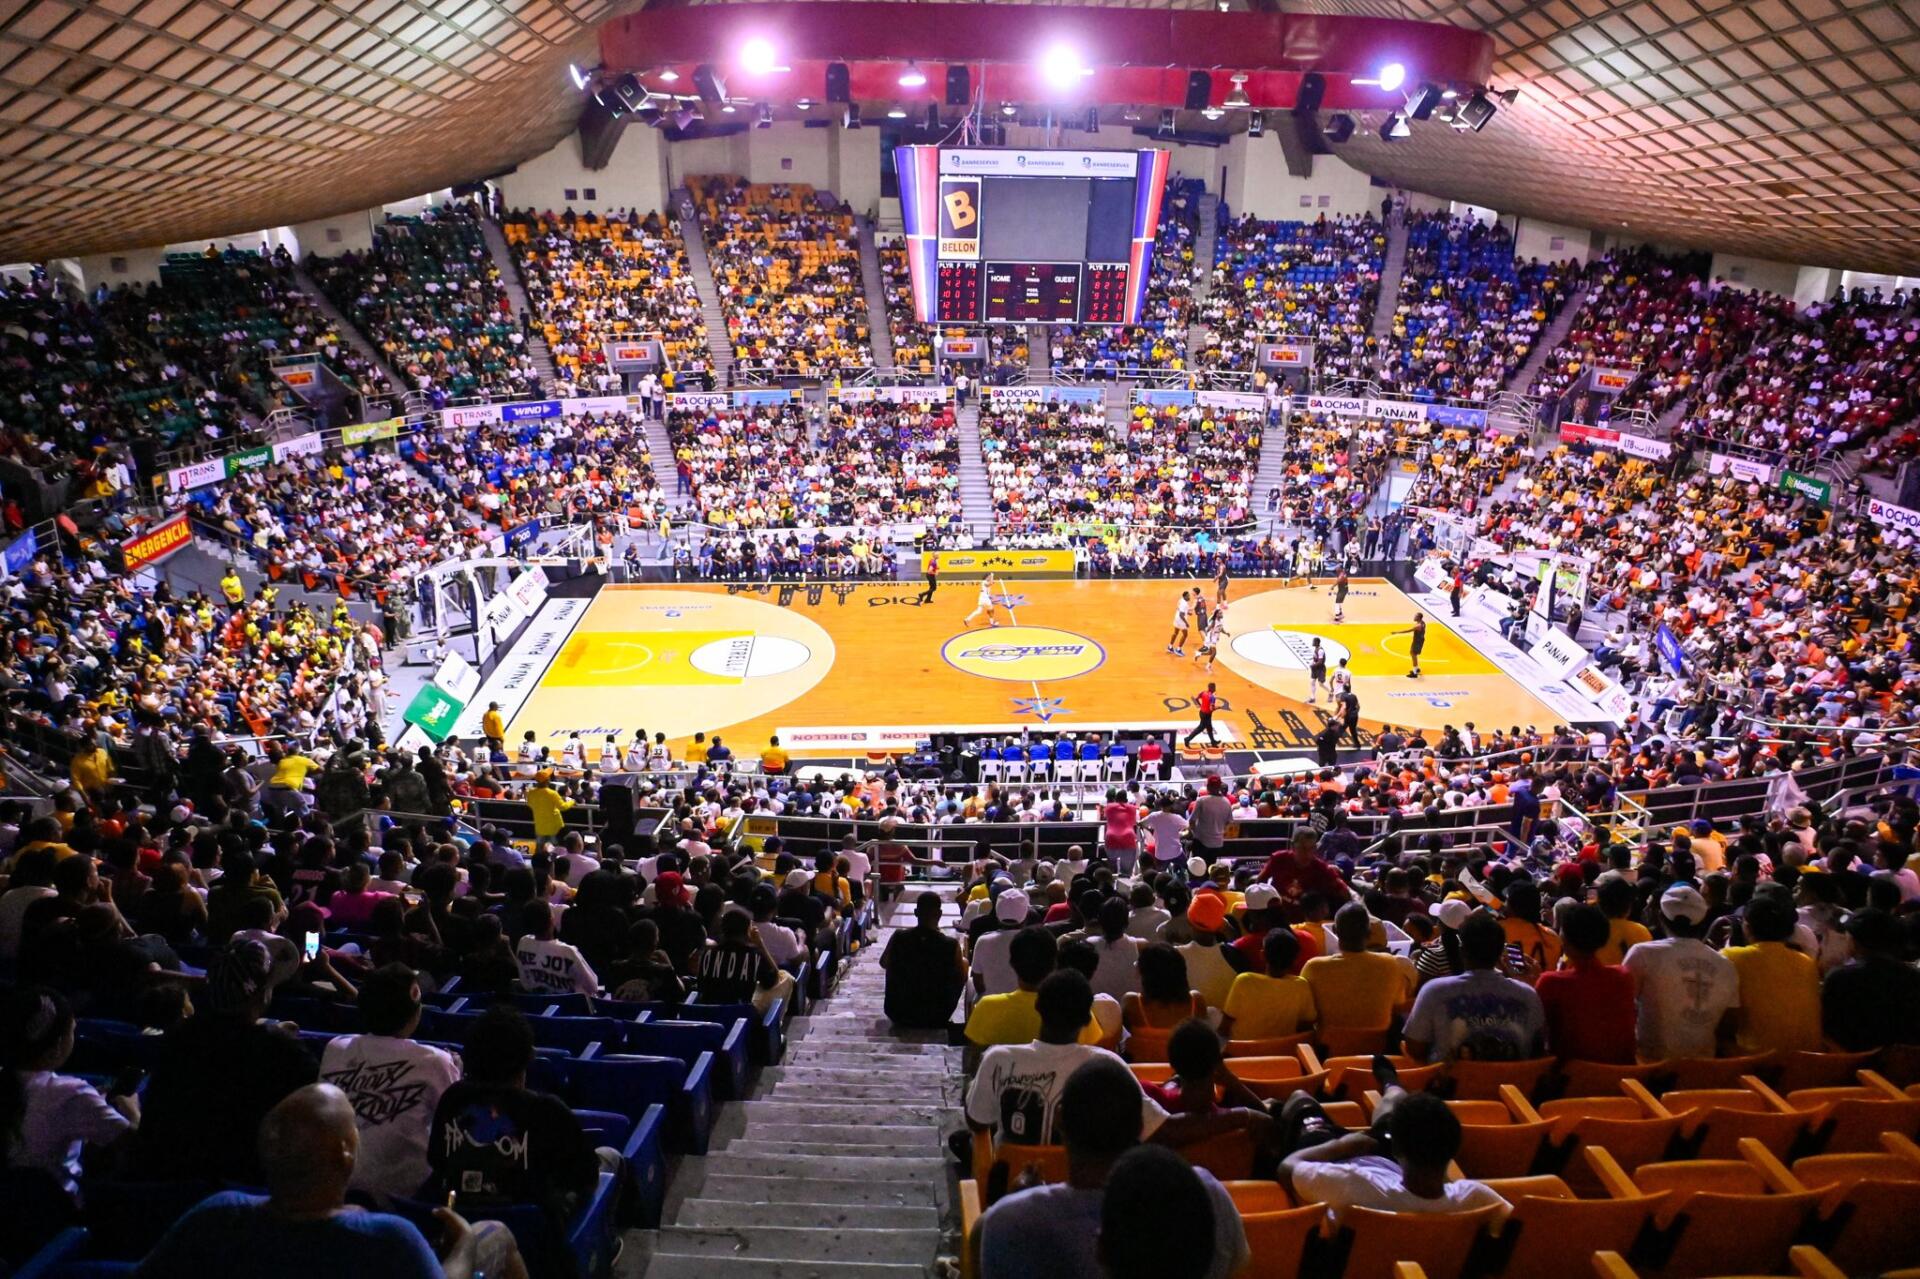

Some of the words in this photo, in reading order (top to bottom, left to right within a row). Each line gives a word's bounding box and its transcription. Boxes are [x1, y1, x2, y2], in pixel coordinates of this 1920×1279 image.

[942, 242, 976, 253] BELLON
[991, 275, 1011, 283] HOME
[1054, 276, 1076, 284] GUEST
[1006, 389, 1040, 397] OCHOA
[689, 396, 725, 405] OCHOA
[1324, 400, 1361, 410] OCHOA
[463, 410, 493, 421] TRANS
[512, 406, 542, 416] WIND
[1375, 406, 1419, 419] PANAM
[239, 451, 268, 467] National
[188, 463, 216, 477] TRANS
[1794, 479, 1824, 496] National
[124, 520, 189, 567] EMERGENCIA
[1542, 641, 1570, 666] PANAM
[504, 661, 535, 689] PANAM
[1585, 670, 1609, 693] BELLON
[793, 734, 848, 742] BELLON
[882, 732, 931, 740] ELLON
[824, 799, 832, 809] 0
[540, 955, 574, 974] JOY
